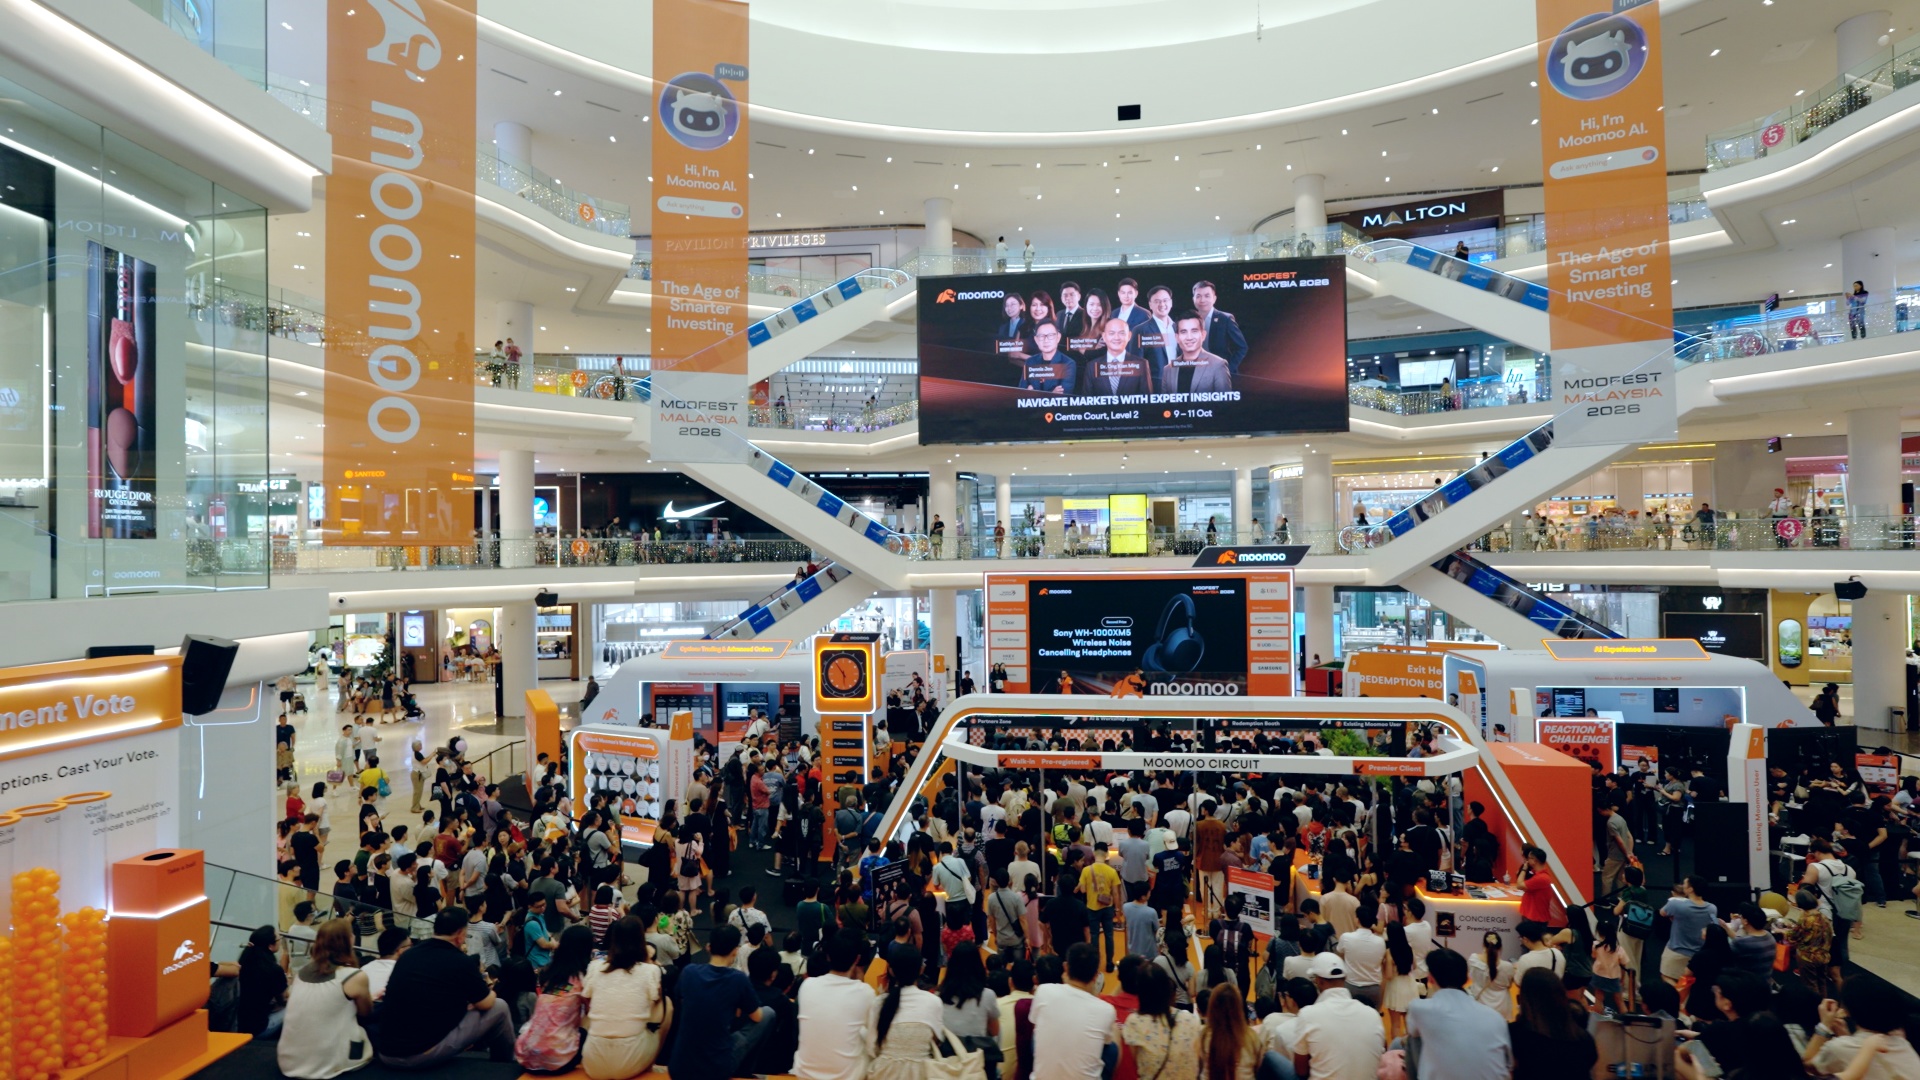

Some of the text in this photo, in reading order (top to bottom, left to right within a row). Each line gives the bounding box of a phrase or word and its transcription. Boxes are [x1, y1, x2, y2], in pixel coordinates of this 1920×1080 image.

[1581, 114, 1624, 131] Hi, I'm
[1559, 129, 1626, 148] Moomoo
[1768, 128, 1779, 143] 5
[684, 164, 719, 177] Hi, I'm
[1575, 160, 1608, 170] anything
[666, 175, 720, 190] Moomoo
[666, 233, 827, 251] PAVILION PRIVILEGES
[1557, 239, 1658, 266] The Age of
[367, 100, 423, 443] moomoo
[1243, 272, 1298, 281] MOOFEST
[1569, 264, 1648, 284] Smarter
[661, 280, 740, 300] The Age of
[1243, 278, 1330, 290] MALAYSIA 2026
[958, 290, 1005, 300] moomoo
[1567, 281, 1653, 303] Investing
[670, 300, 731, 315] Smarter
[667, 315, 734, 336] Investing
[1564, 372, 1662, 389] MOOFEST
[1017, 391, 1241, 408] NAVIGATE MARKETS WITH EXPERT INSIGHTS
[1564, 387, 1663, 404] MALAYSIA
[661, 400, 738, 411] MOOFEST
[1587, 404, 1641, 417] 2026
[660, 413, 738, 424] MALAYSIA
[1055, 409, 1213, 421] Centre Court, Level 2 9 11 Oct
[679, 427, 721, 437] 2026
[94, 488, 152, 502] ROUGE DIOR
[1785, 521, 1796, 536] 3
[1238, 553, 1287, 562] moomoo
[1053, 629, 1132, 638] Sony WH-1000XM5
[1072, 638, 1132, 646] Wireless Noise
[1038, 648, 1132, 657] Cancelling Headphones
[1407, 664, 1442, 675] Exit He
[1360, 675, 1425, 688] REDEMPTION
[1150, 681, 1239, 696] moomoo
[73, 694, 136, 719] Vote
[1232, 720, 1263, 728] Redemption
[1543, 725, 1597, 734] REACTION
[1549, 735, 1611, 744] CHALLENGE
[57, 762, 90, 779] Cast
[93, 754, 124, 770] Your
[126, 749, 159, 764] Vote.
[1010, 758, 1090, 767] Walk-in Pre-registered
[1143, 758, 1260, 769] MOOMOO CIRCUIT
[1368, 764, 1398, 772] Premier
[125, 805, 155, 820] would
[1458, 915, 1507, 923] CONCIERGE
[162, 952, 205, 975] moomoo
